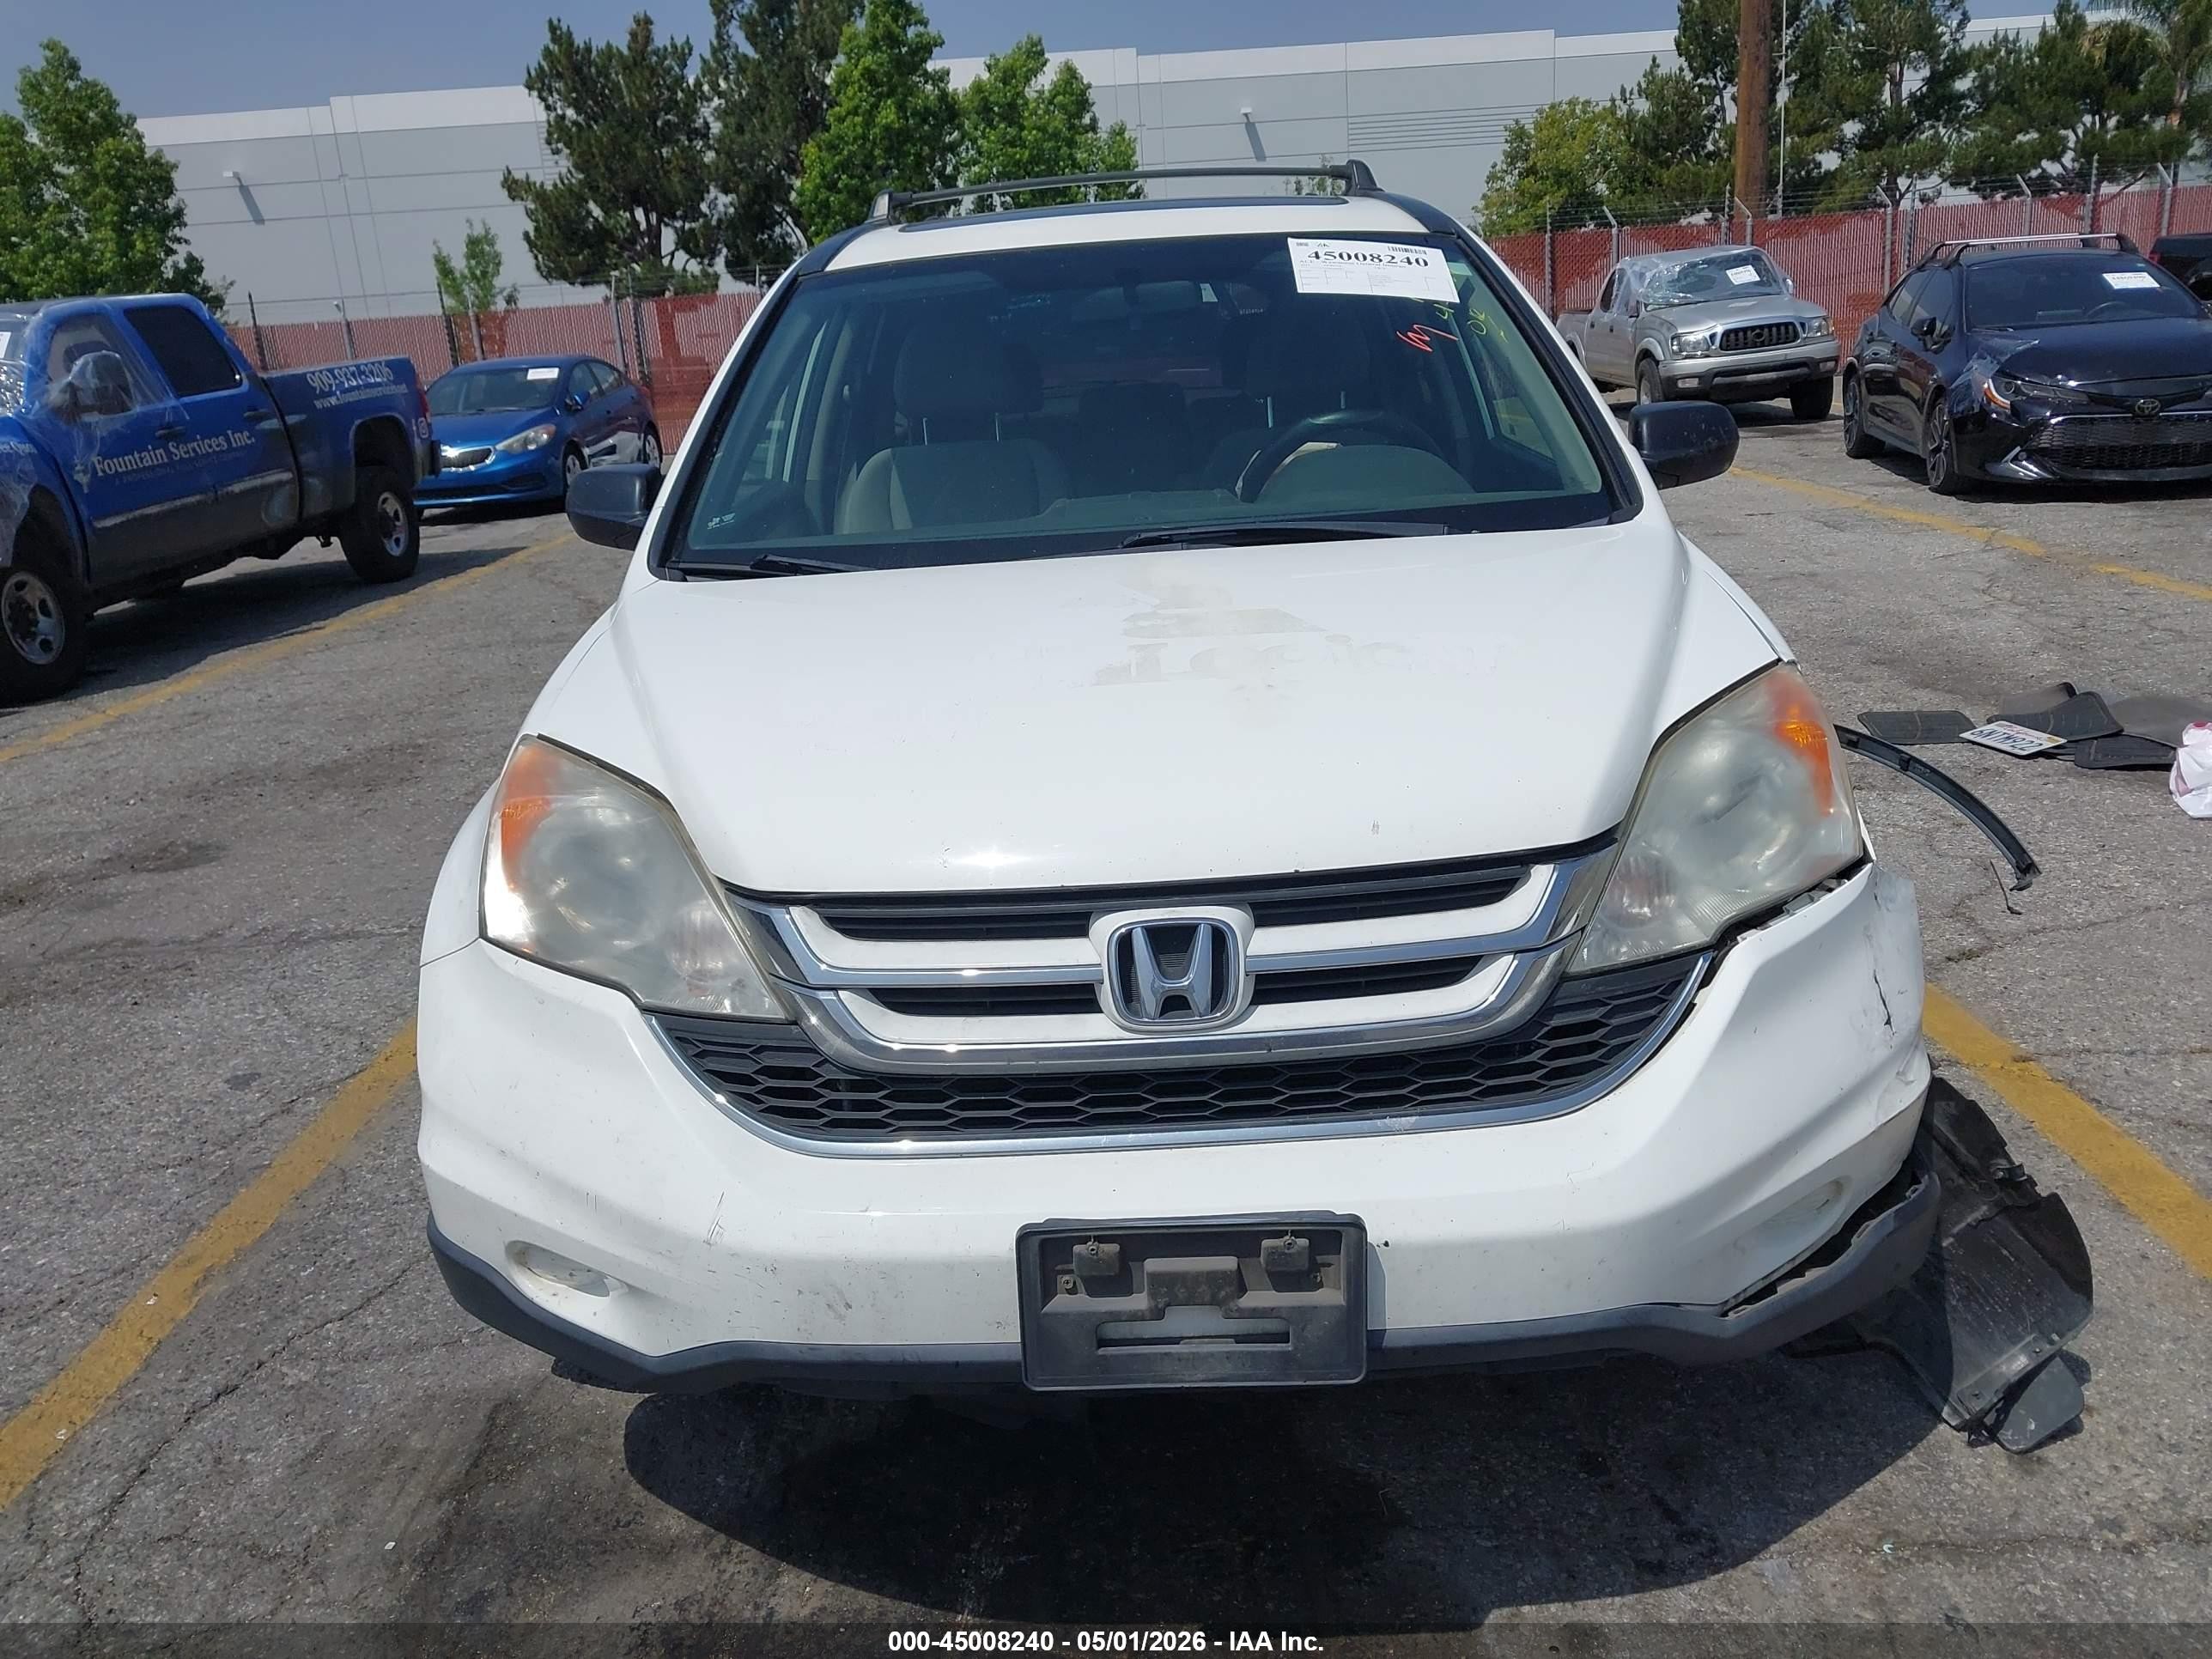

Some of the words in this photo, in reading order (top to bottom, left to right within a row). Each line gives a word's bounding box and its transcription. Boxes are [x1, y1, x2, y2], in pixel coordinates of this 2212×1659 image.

[1307, 249, 1429, 267] 45008240
[306, 361, 394, 394] 909-937-3206
[94, 444, 168, 477] Fountain
[168, 434, 228, 461] Services
[227, 429, 256, 448] Inc.
